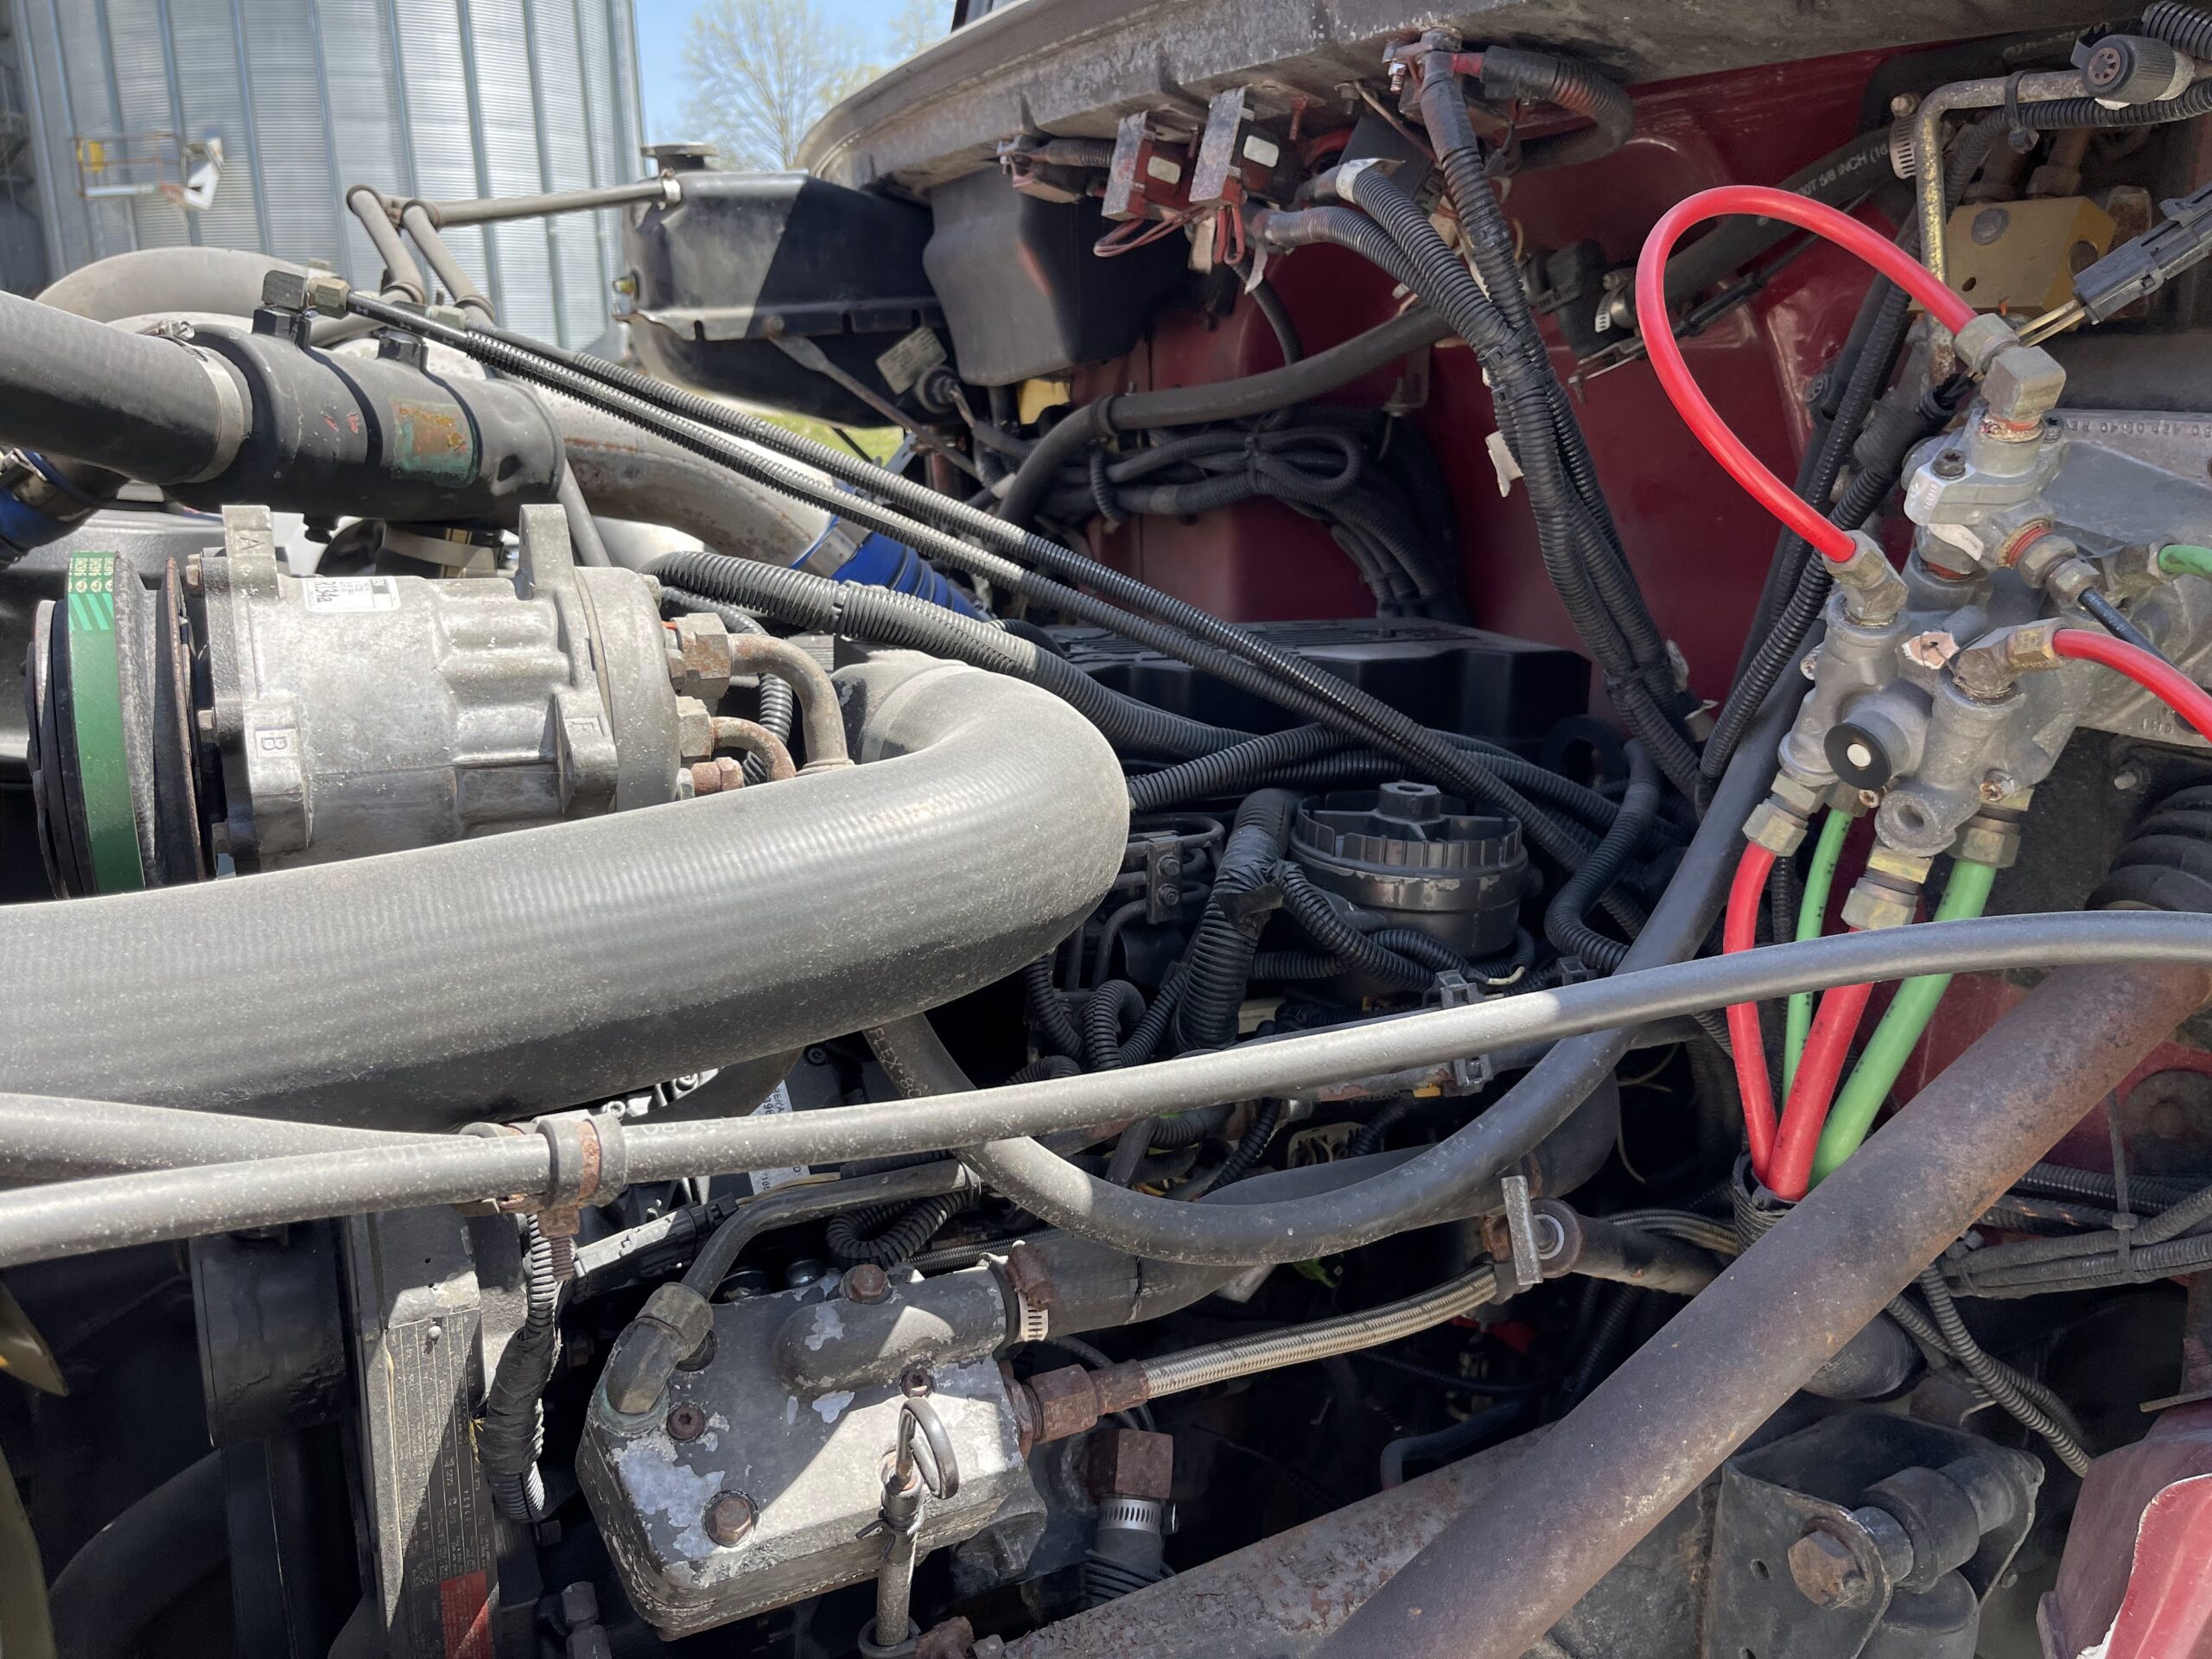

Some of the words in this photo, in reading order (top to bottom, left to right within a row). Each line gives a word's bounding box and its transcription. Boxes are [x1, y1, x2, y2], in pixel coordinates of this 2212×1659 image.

[238, 536, 266, 552] A
[314, 580, 340, 603] R134a
[260, 735, 289, 752] B
